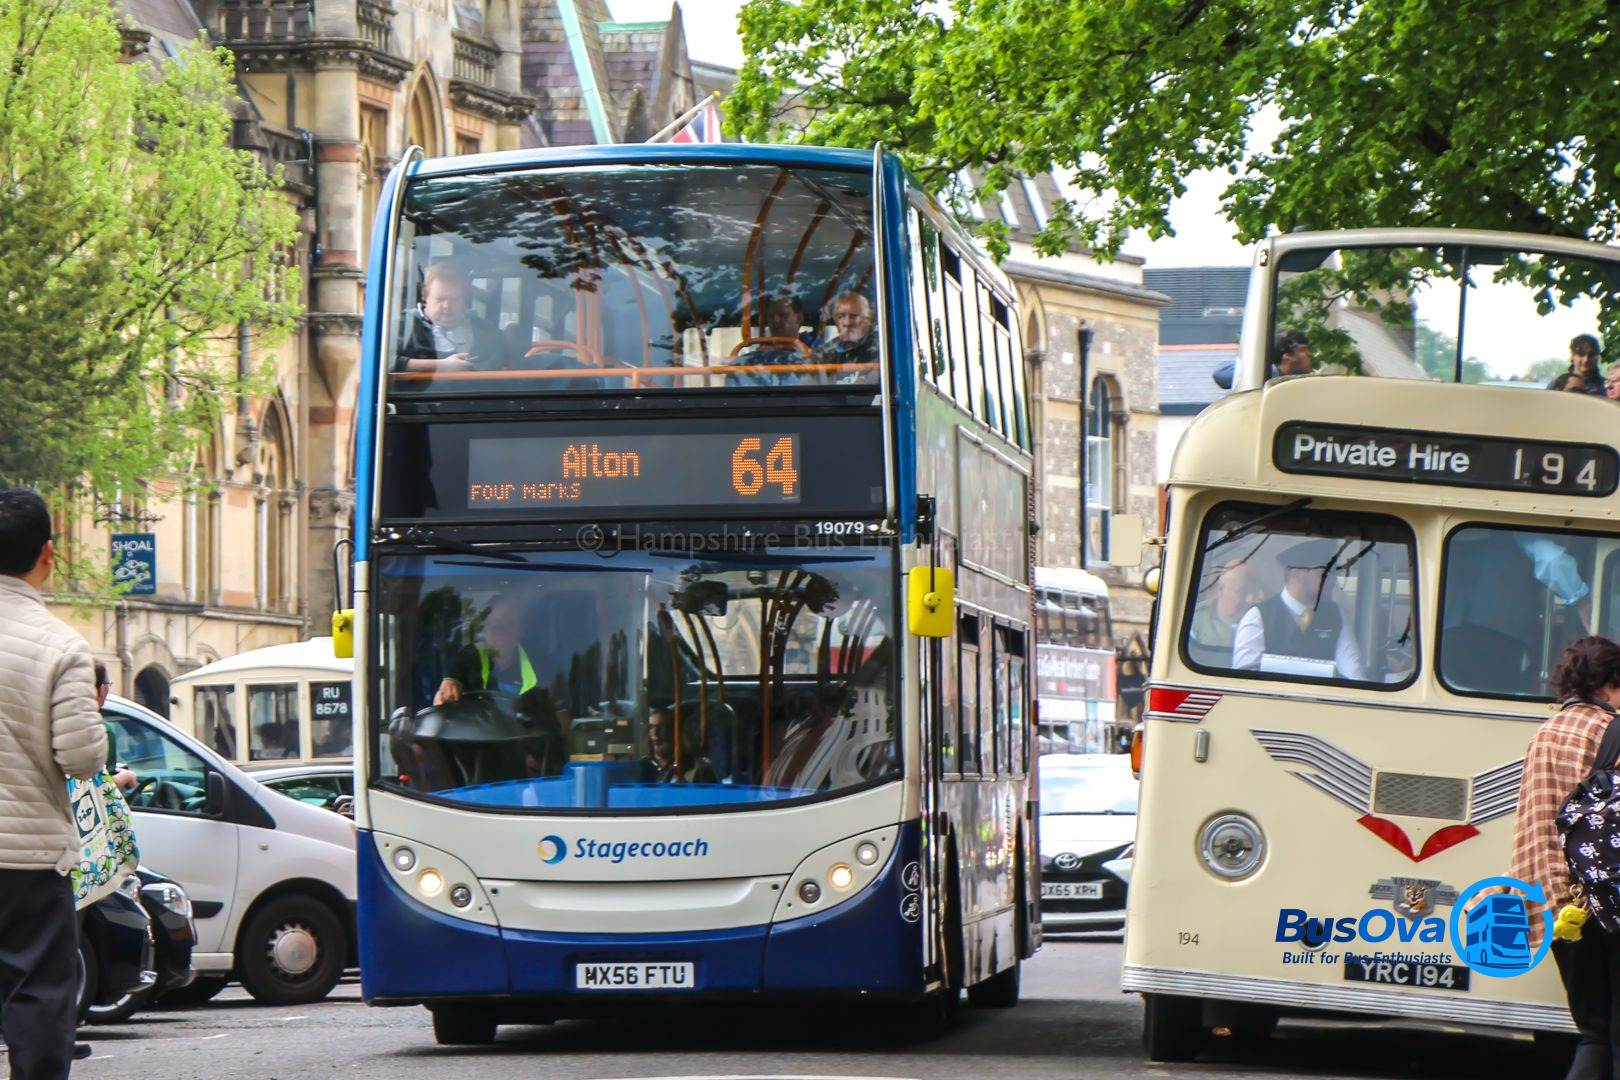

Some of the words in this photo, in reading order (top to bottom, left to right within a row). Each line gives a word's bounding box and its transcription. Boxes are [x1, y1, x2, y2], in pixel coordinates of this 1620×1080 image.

[1293, 434, 1397, 467] Private
[1409, 444, 1470, 473] Hire
[563, 444, 639, 477] Alton
[731, 437, 798, 494] 64
[815, 521, 864, 534] 19079
[112, 540, 153, 551] SHOAL
[322, 687, 340, 699] RU
[316, 702, 348, 715] 8678
[574, 837, 709, 864] Stagecoach
[1178, 932, 1200, 946] 194
[585, 967, 638, 985] MX56
[645, 966, 686, 984] FTU
[1361, 960, 1409, 984] YRC
[1416, 964, 1455, 988] 194
